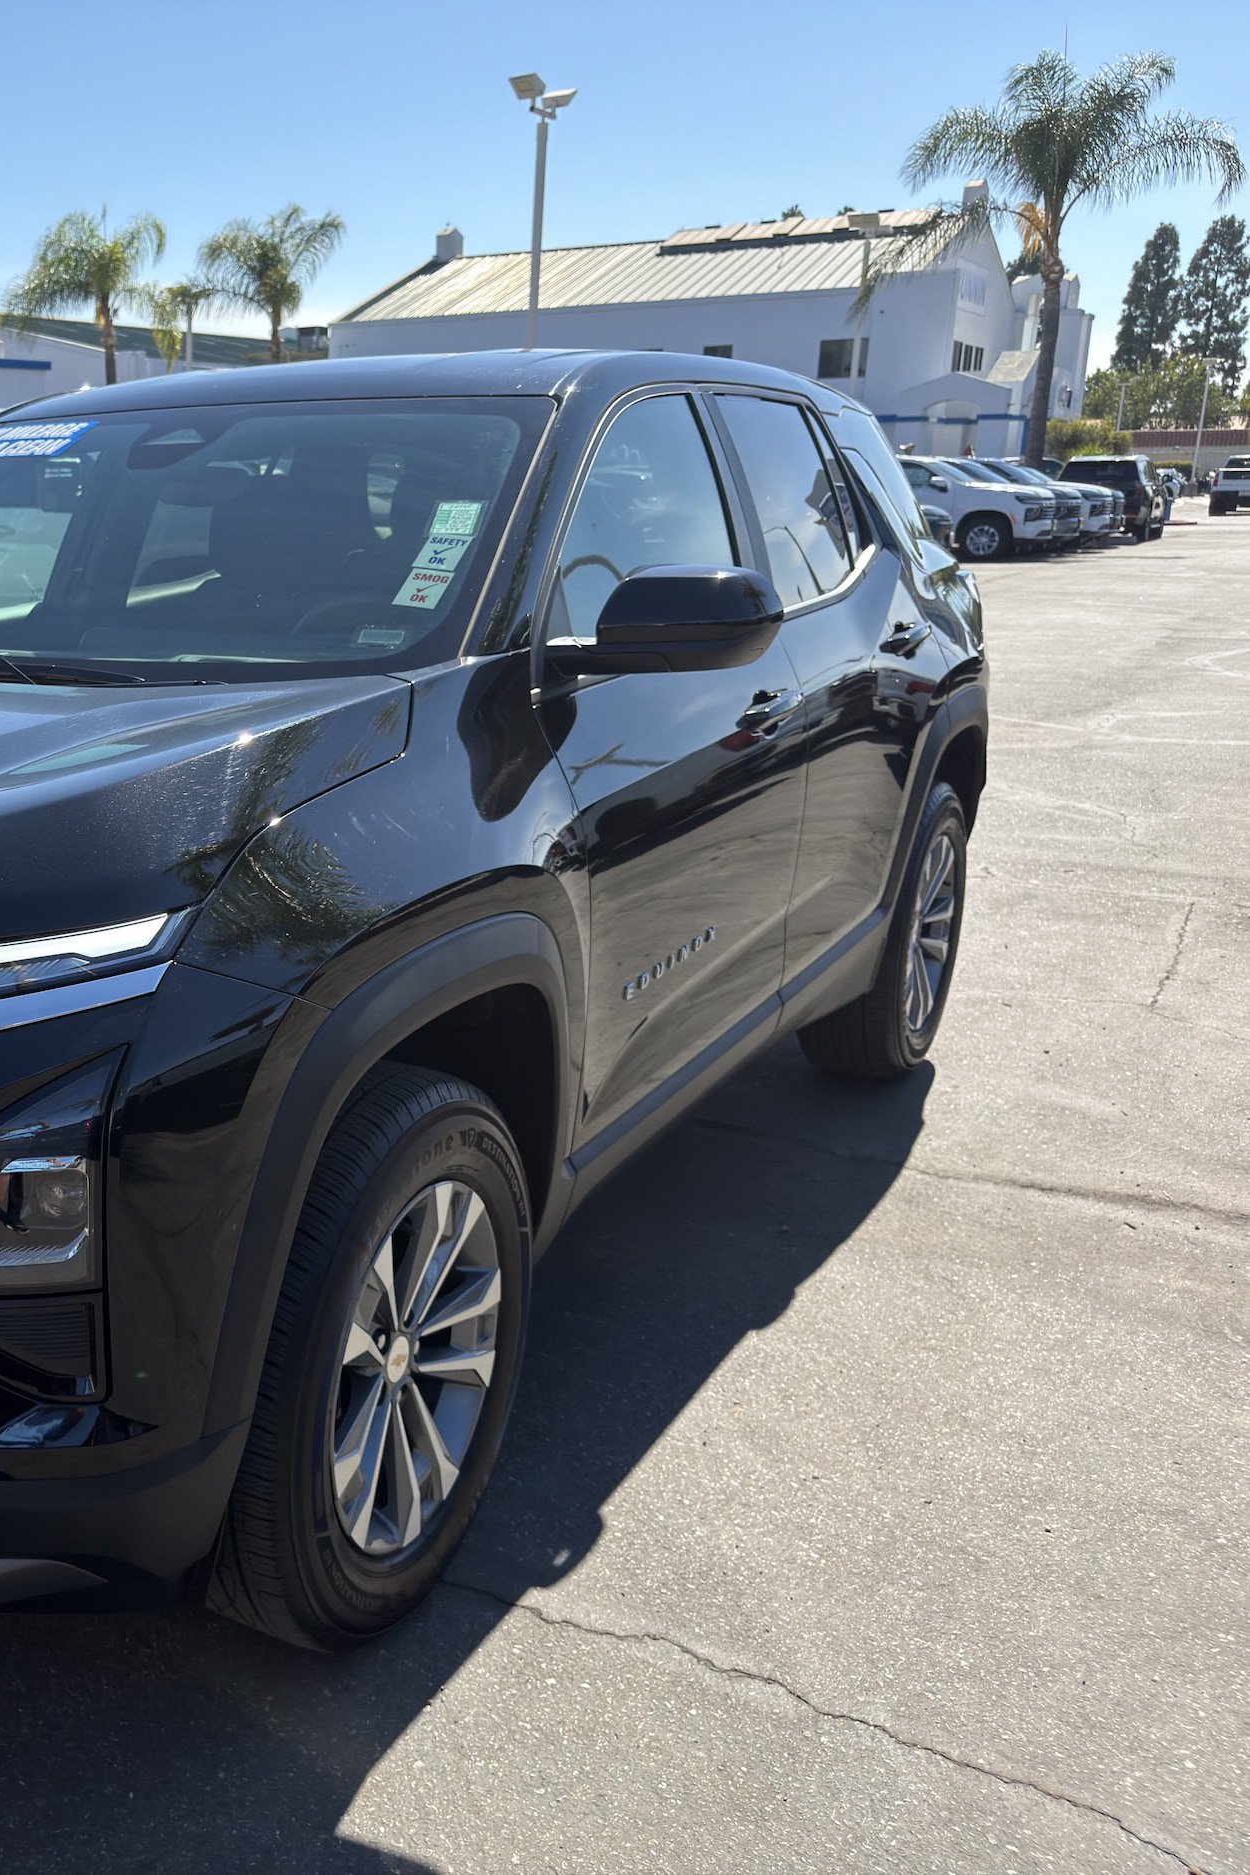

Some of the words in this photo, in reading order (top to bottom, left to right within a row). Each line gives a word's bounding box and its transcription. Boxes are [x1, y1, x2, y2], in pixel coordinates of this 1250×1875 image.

[429, 536, 469, 548] SAFETY
[428, 556, 447, 566] OK
[412, 572, 450, 585] SMOG
[409, 593, 428, 604] OK
